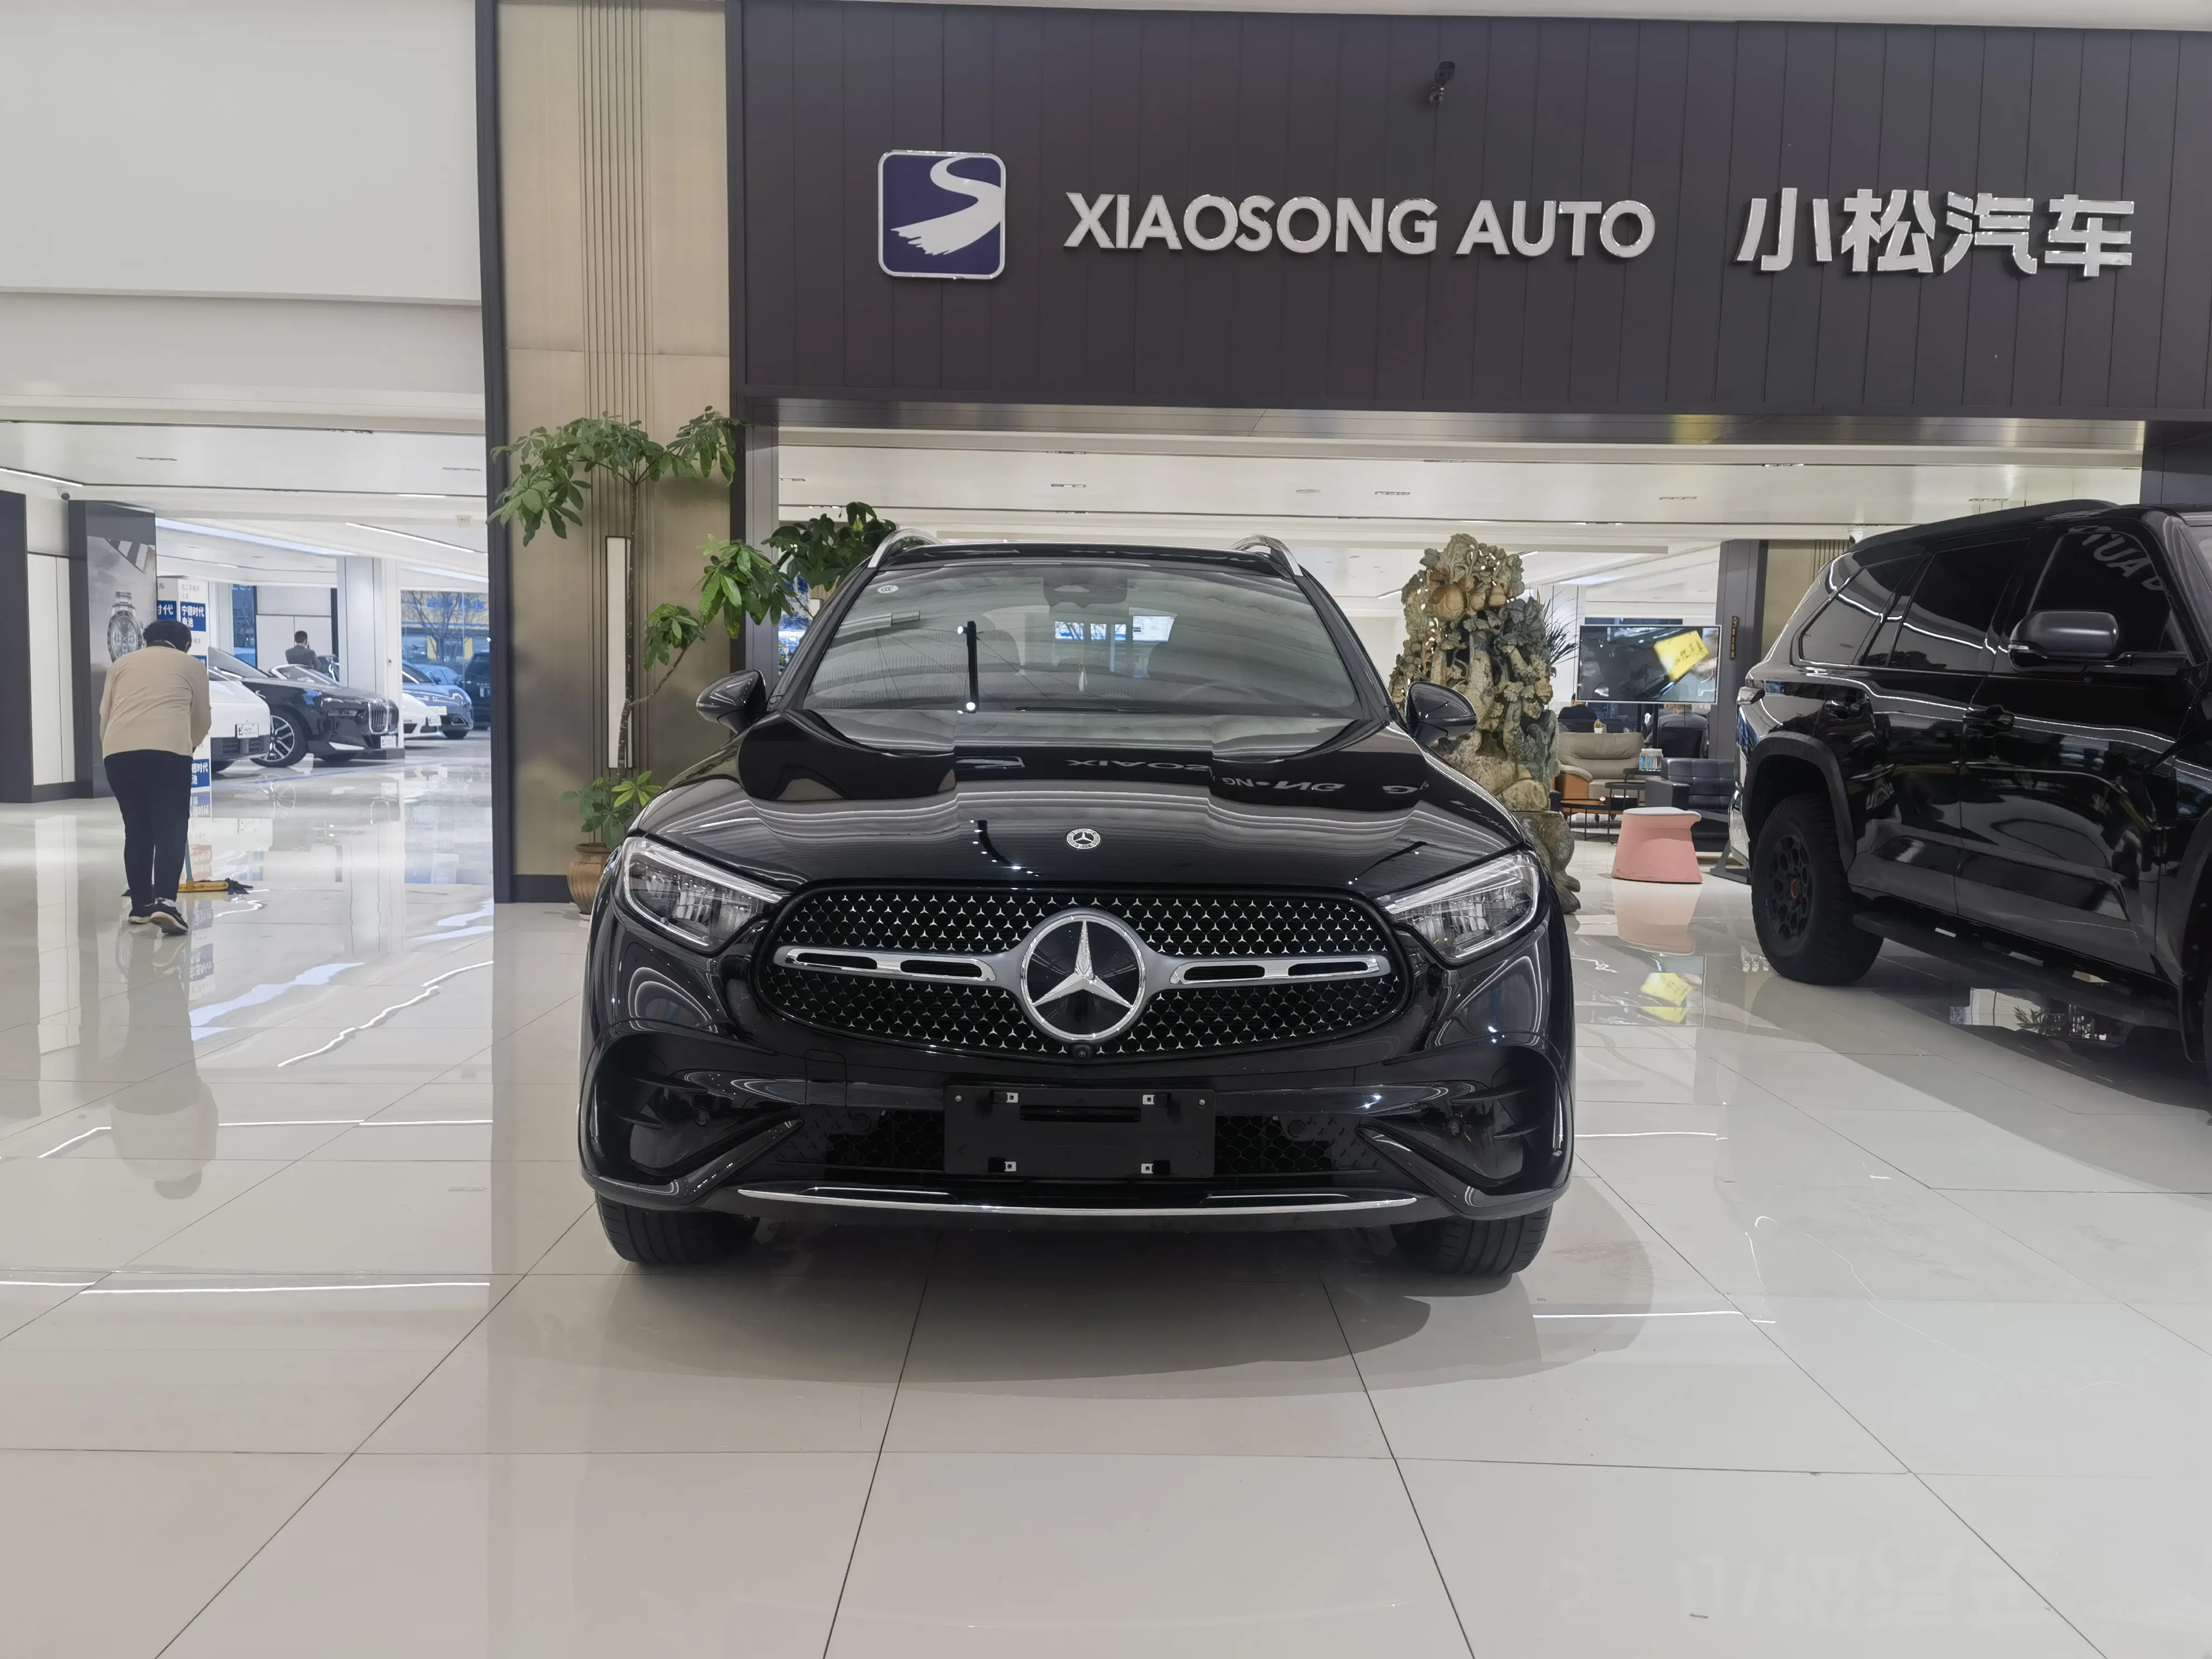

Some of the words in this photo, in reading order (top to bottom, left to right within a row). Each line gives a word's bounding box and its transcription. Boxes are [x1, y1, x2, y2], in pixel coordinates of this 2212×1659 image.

[1063, 192, 1439, 256] XIAOSONG
[1455, 200, 1656, 258] AUTO
[1735, 187, 2135, 276] 小松汽车
[181, 605, 205, 618] 宁德时代
